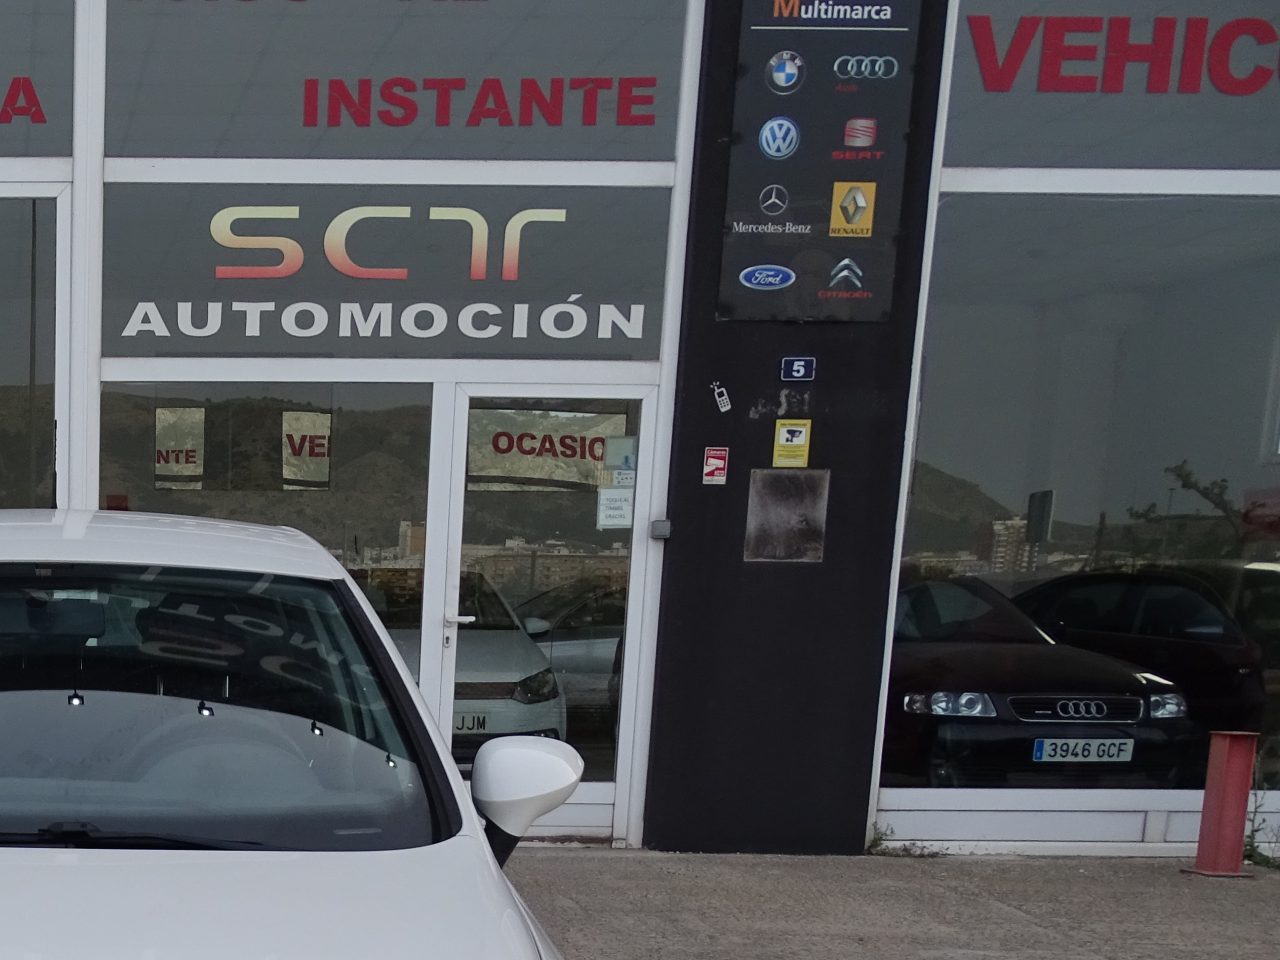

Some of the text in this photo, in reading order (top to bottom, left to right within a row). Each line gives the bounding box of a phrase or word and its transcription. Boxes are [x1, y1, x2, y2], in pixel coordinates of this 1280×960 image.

[773, 0, 892, 20] Multimarca
[967, 15, 1280, 96] VEHIC
[302, 76, 657, 127] INSTANTE
[732, 221, 812, 234] Mercedes-Benz
[830, 227, 871, 236] RENAULT
[751, 270, 782, 285] Ford
[121, 293, 645, 339] AUTOMOCIÓN
[791, 360, 806, 378] 5
[156, 449, 197, 465] NTE
[455, 715, 486, 731] JJM
[1048, 742, 1128, 759] 3946 GCF
